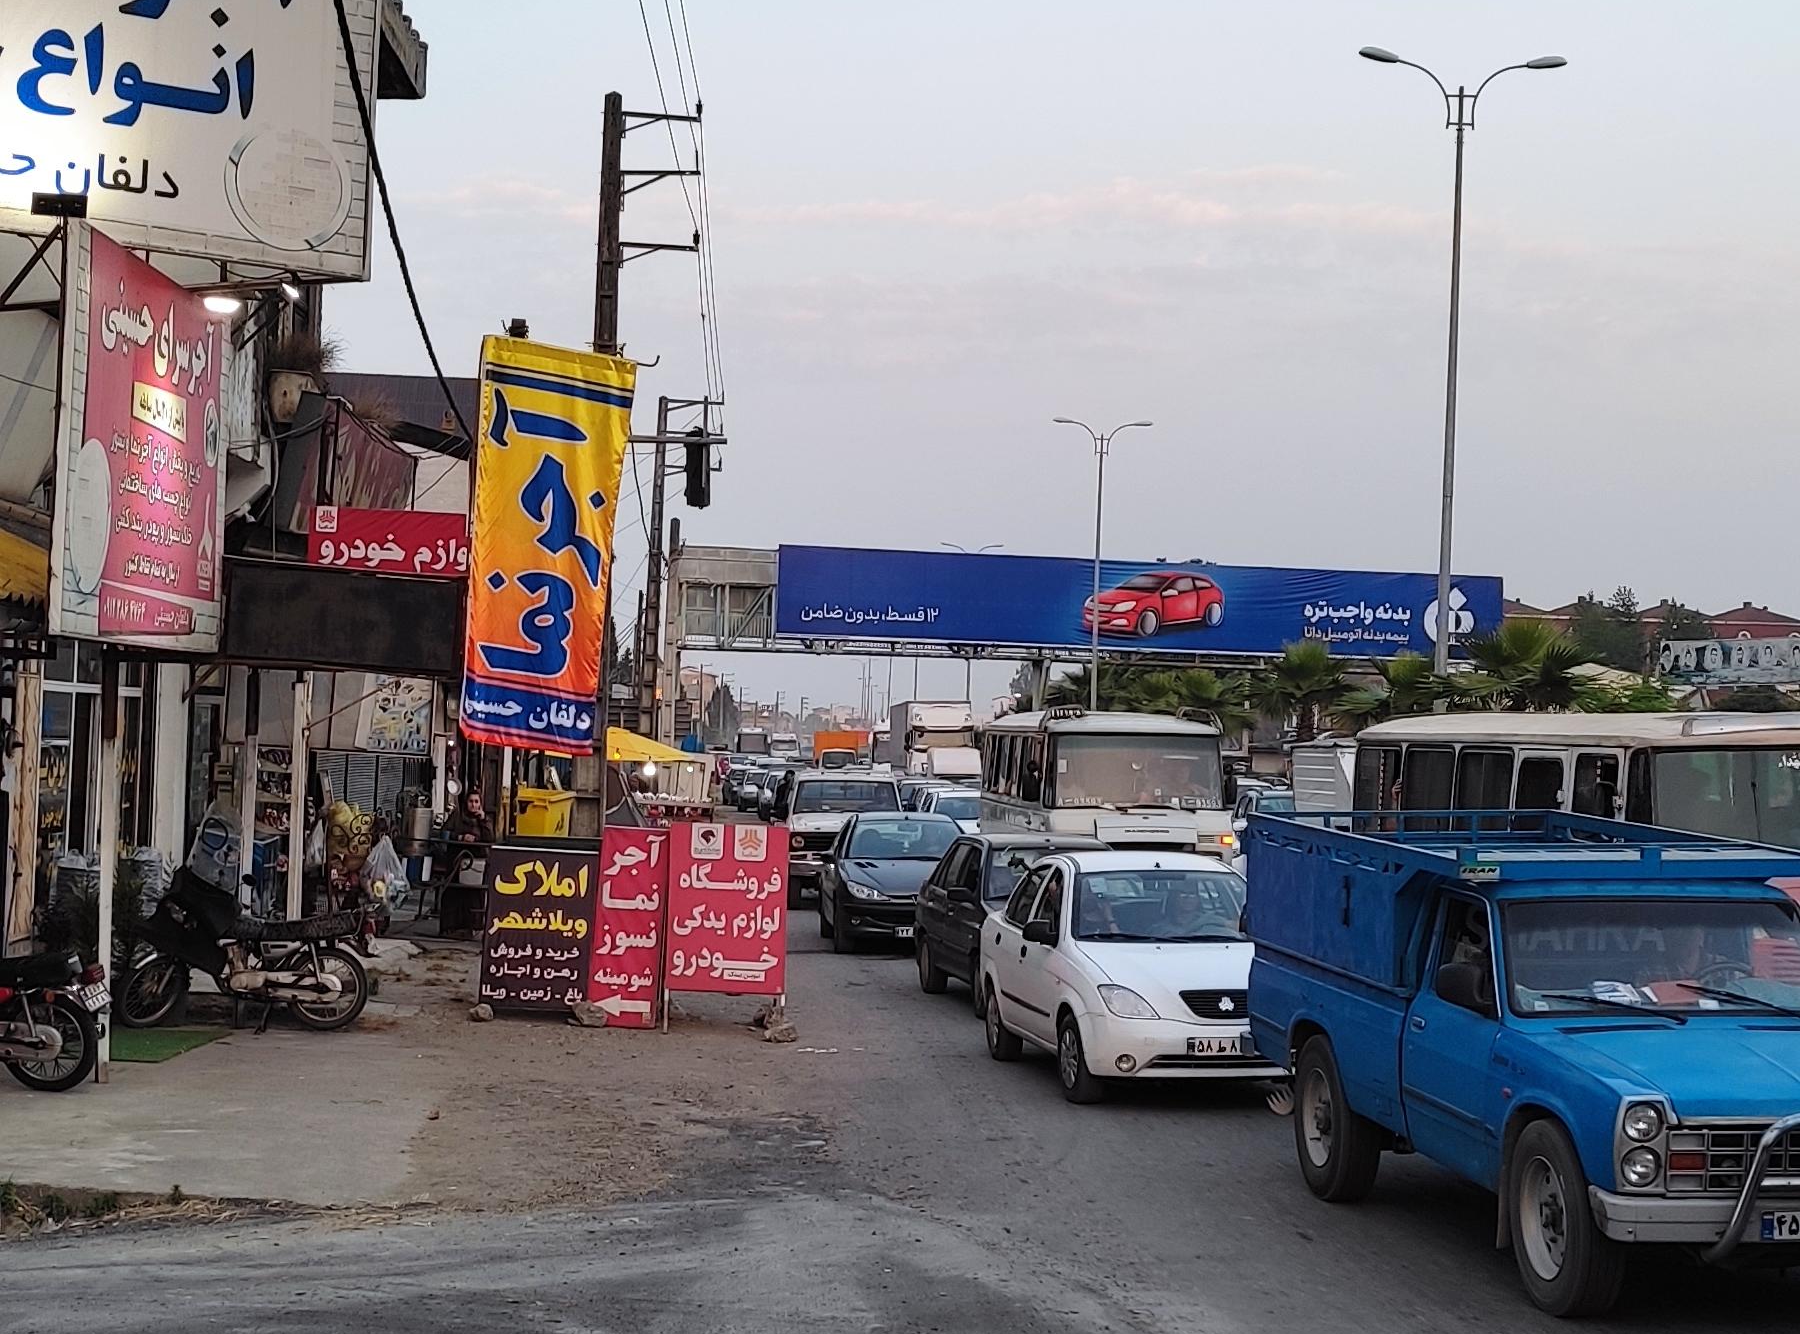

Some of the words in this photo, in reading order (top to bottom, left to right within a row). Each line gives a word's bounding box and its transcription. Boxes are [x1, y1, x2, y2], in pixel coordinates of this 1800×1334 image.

[16, 20, 255, 127] انواع
[55, 153, 180, 199] دلفان
[101, 276, 155, 357] حسینی
[317, 532, 407, 568] خودرو
[413, 538, 469, 574] وازم
[800, 602, 844, 622] ضامن
[844, 606, 880, 624] بدون
[926, 607, 940, 623] ۱۲
[1375, 602, 1411, 626] بدنه
[603, 834, 667, 876] آجر
[494, 859, 589, 898] املاک
[679, 862, 782, 900] فروشگاه
[1461, 866, 1498, 874] IRAN
[602, 879, 660, 911] نما
[672, 903, 727, 936] یدکی
[732, 904, 781, 940] لوازم
[489, 942, 533, 959] فروش
[595, 921, 658, 956] نسوز
[534, 947, 543, 959] و
[545, 946, 580, 961] خرید
[670, 945, 779, 977] خودرو
[489, 962, 531, 979] اجاره
[532, 967, 541, 979] و
[543, 968, 579, 981] رهن
[481, 983, 507, 999] ویلا
[519, 984, 552, 1001] زمین
[563, 987, 583, 1006] باغ
